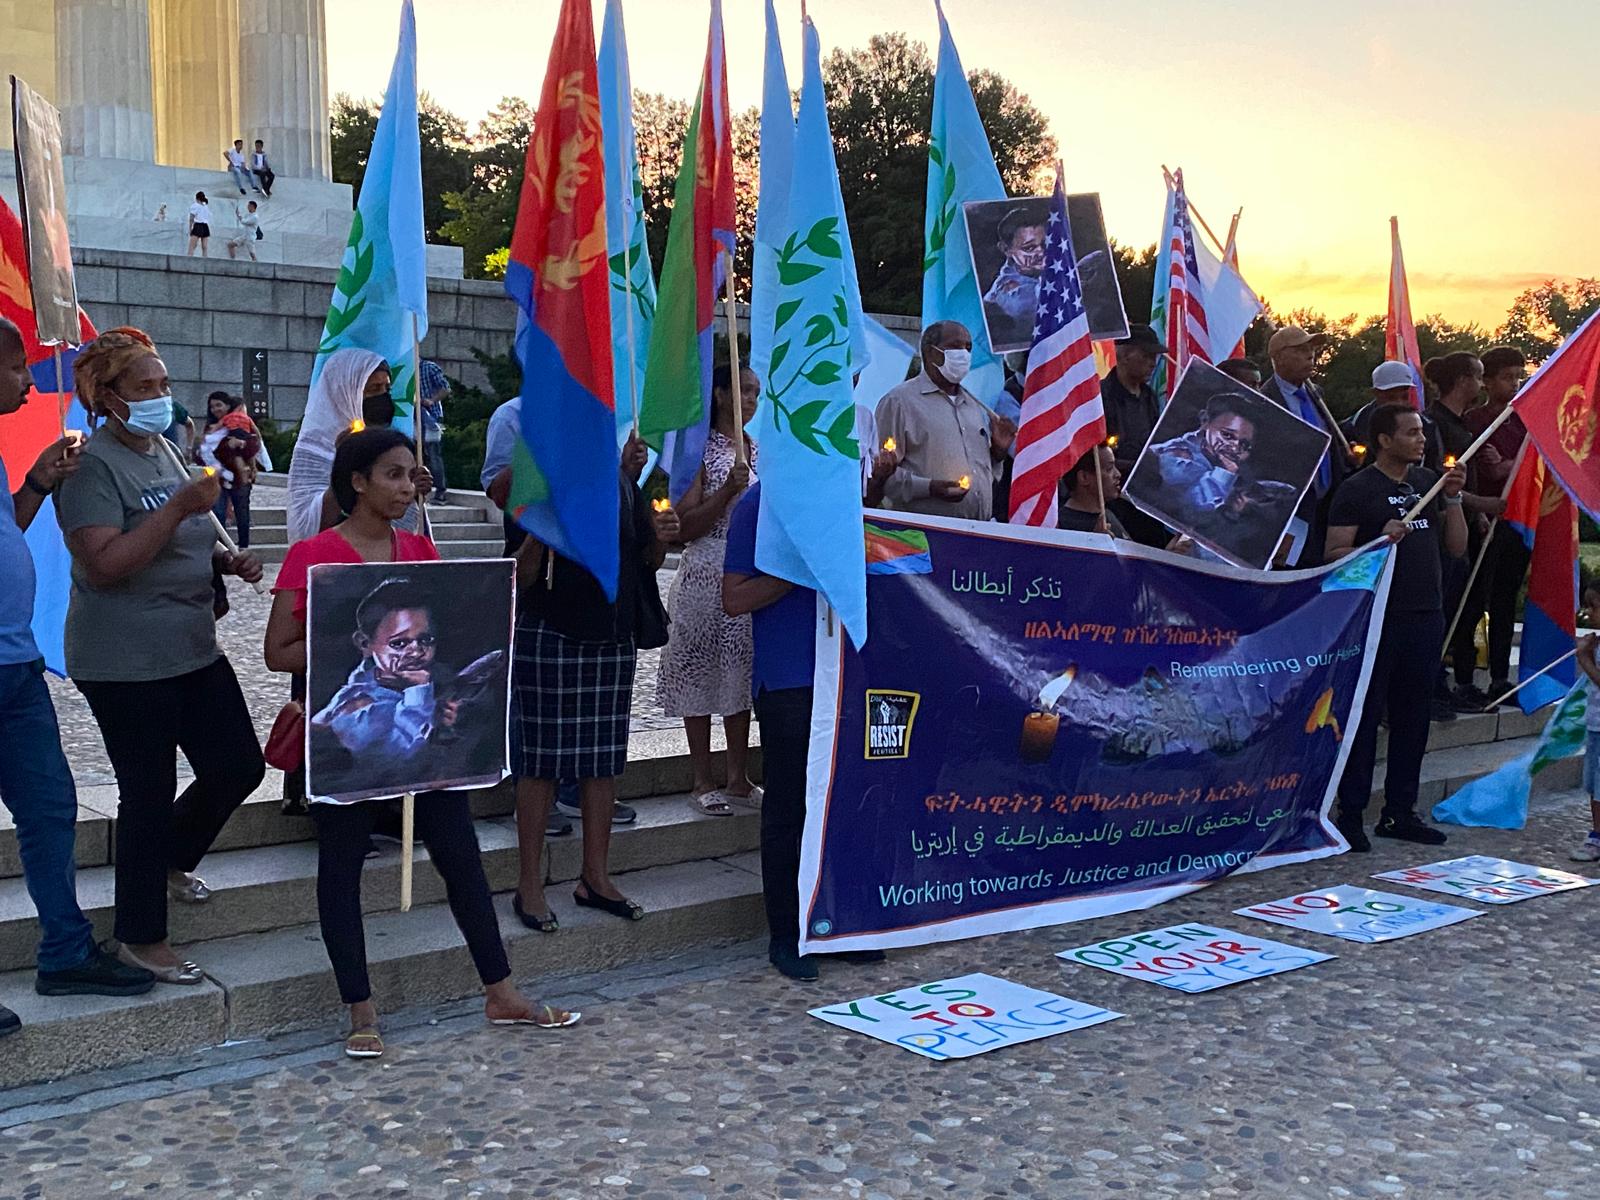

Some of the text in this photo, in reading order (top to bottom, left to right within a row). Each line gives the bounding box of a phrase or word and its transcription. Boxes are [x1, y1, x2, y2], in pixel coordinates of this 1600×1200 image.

[1406, 519, 1430, 529] ATTER
[952, 566, 1062, 604] تذكر أبطالنا
[1170, 657, 1300, 678] Remembering
[1306, 653, 1335, 667] our
[870, 725, 906, 748] RESIST
[994, 822, 1123, 852] والديمقراطية
[1129, 815, 1194, 838] العدالة
[1195, 805, 1254, 837] لتحقيق
[911, 826, 958, 859] إريتريا
[964, 825, 985, 857] في
[878, 850, 1258, 907] Working towards Justice and Democr
[1248, 895, 1340, 921] NO
[1331, 901, 1406, 917] TO
[1074, 926, 1219, 967] OPEN
[1121, 940, 1262, 976] YOUR
[1154, 951, 1315, 992] EYES
[822, 984, 977, 1023] YES
[910, 1002, 996, 1027] TO
[897, 999, 1109, 1058] PEACE
